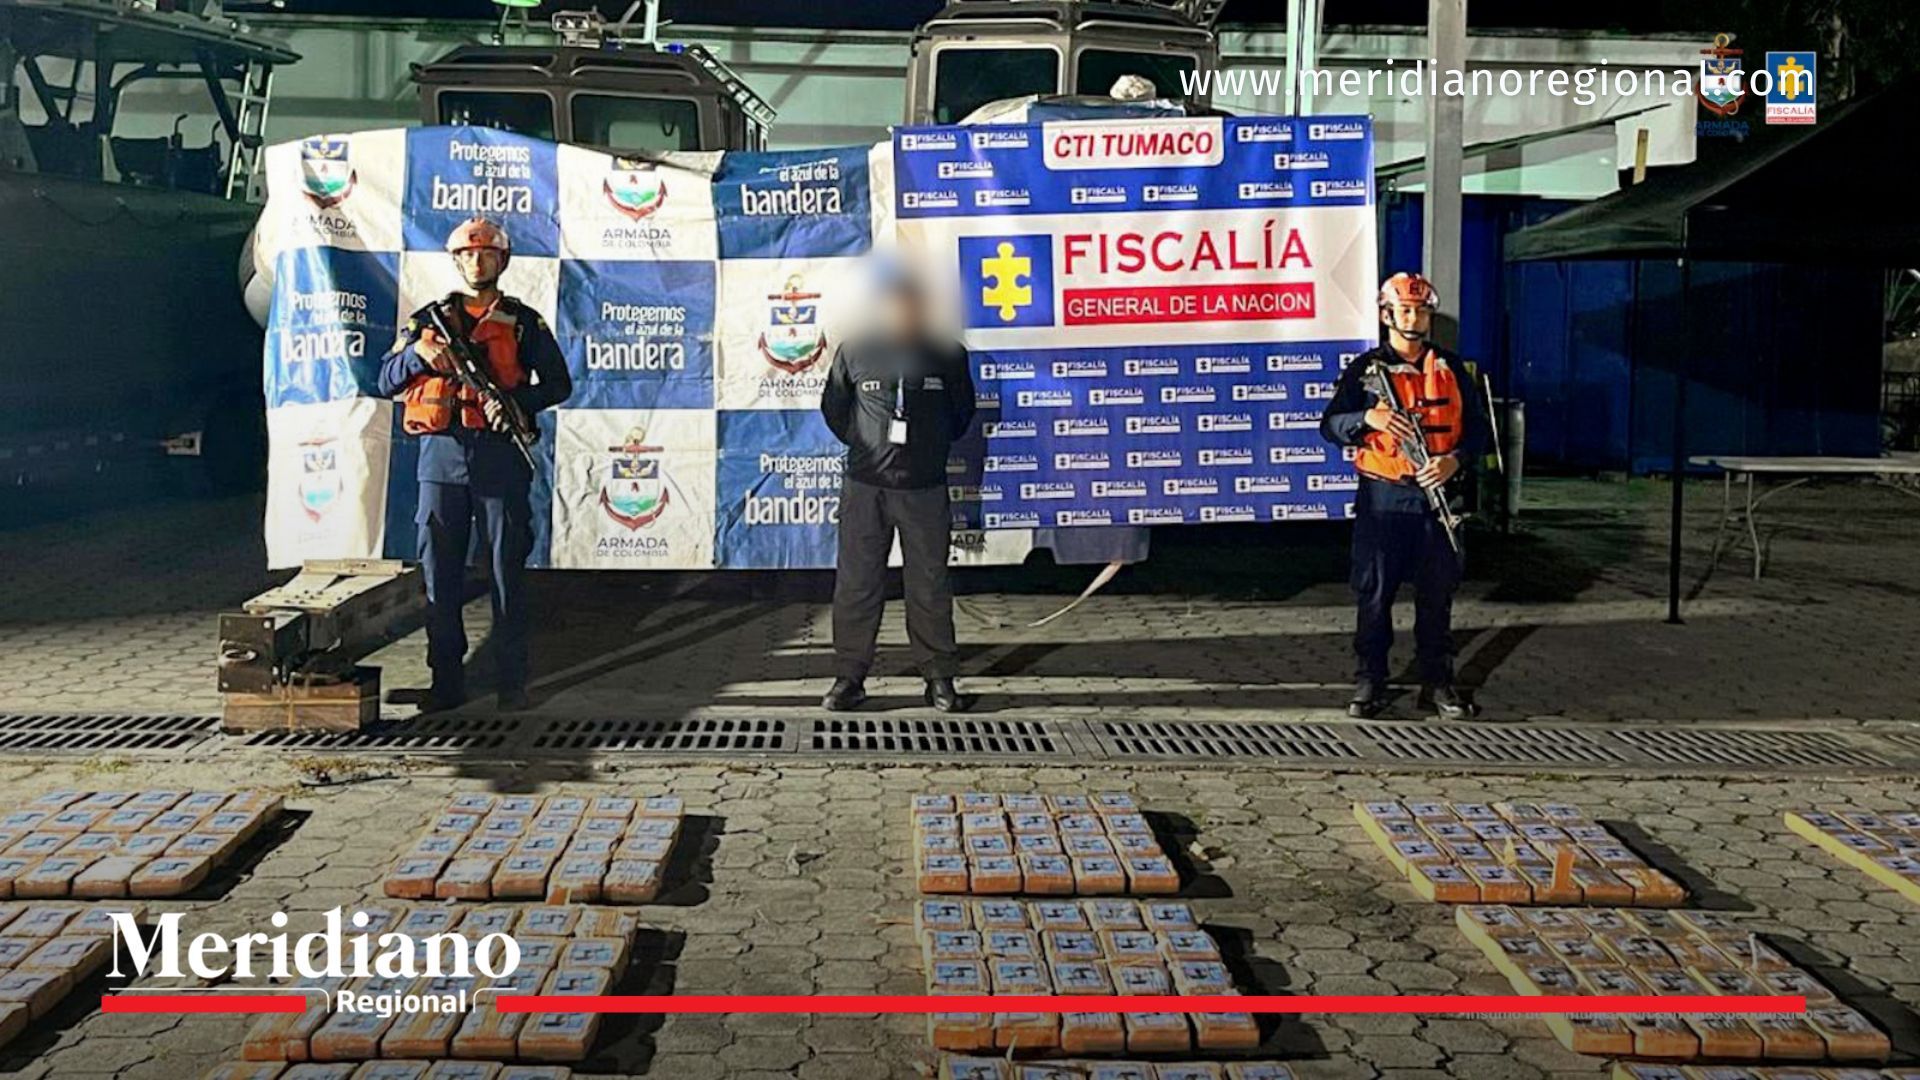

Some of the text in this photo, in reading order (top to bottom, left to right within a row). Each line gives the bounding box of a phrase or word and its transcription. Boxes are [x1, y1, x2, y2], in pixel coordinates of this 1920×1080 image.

[1254, 125, 1292, 133] FISCALÍA
[1325, 123, 1363, 132] FISCALÍA
[918, 133, 956, 143] FISCALÍA
[990, 132, 1028, 141] FISCALÍA
[1054, 132, 1213, 157] CTI TUMACO
[449, 140, 530, 164] Protegemos
[1290, 153, 1328, 161] FISCALÍA
[954, 161, 993, 170] FISCALÍA
[779, 168, 789, 182] el
[791, 167, 813, 182] azul
[814, 165, 828, 180] de
[829, 165, 839, 180] la
[1255, 182, 1293, 191] FISCALÍA
[1327, 180, 1364, 189] FISCALÍA
[432, 175, 532, 213] bandera
[991, 190, 1029, 198] FISCALÍA
[1087, 187, 1126, 195] FISCALÍA
[1159, 185, 1197, 194] FISCALÍA
[741, 182, 841, 215] bandera
[919, 191, 957, 199] FISCALÍA
[603, 228, 672, 239] ARMADA
[1064, 219, 1313, 275] FISCALÍA
[1068, 292, 1311, 317] GENERAL DE LA NACION
[602, 302, 686, 325] Protegemos
[586, 335, 685, 370] bandera
[1140, 357, 1178, 367] FISCALÍA
[1212, 357, 1250, 365] FISCALÍA
[1283, 355, 1322, 363] FISCALÍA
[997, 362, 1035, 371] FISCALÍA
[1068, 360, 1106, 369] FISCALÍA
[760, 377, 828, 389] ARMADA
[862, 381, 880, 391] CTI
[1104, 388, 1144, 397] FISCALÍA
[1177, 386, 1215, 394] FISCALÍA
[1248, 384, 1287, 392] FISCALÍA
[1033, 390, 1072, 399] FISCALÍA
[1070, 419, 1108, 427] FISCALÍA
[1141, 416, 1180, 425] FISCALÍA
[1214, 414, 1251, 423] FISCALÍA
[998, 421, 1036, 430] FISCALÍA
[1142, 450, 1181, 460] FISCALÍA
[1214, 449, 1252, 458] FISCALÍA
[1287, 447, 1325, 456] FISCALÍA
[1000, 456, 1037, 464] FISCALÍA
[1071, 453, 1109, 462] FISCALÍA
[760, 453, 843, 476] Protegemos
[784, 474, 793, 489] el
[795, 474, 816, 489] azul
[818, 474, 832, 489] de
[1107, 481, 1146, 490] FISCALÍA
[1179, 479, 1217, 488] FISCALÍA
[1251, 477, 1289, 486] FISCALÍA
[1036, 483, 1074, 491] FISCALÍA
[745, 490, 840, 524] bandera
[1143, 507, 1182, 516] FISCALÍA
[1216, 505, 1254, 514] FISCALÍA
[1288, 504, 1327, 512] FISCALÍA
[1001, 513, 1039, 521] FISCALÍA
[1073, 510, 1111, 519] FISCALÍA
[597, 537, 668, 548] ARMADA
